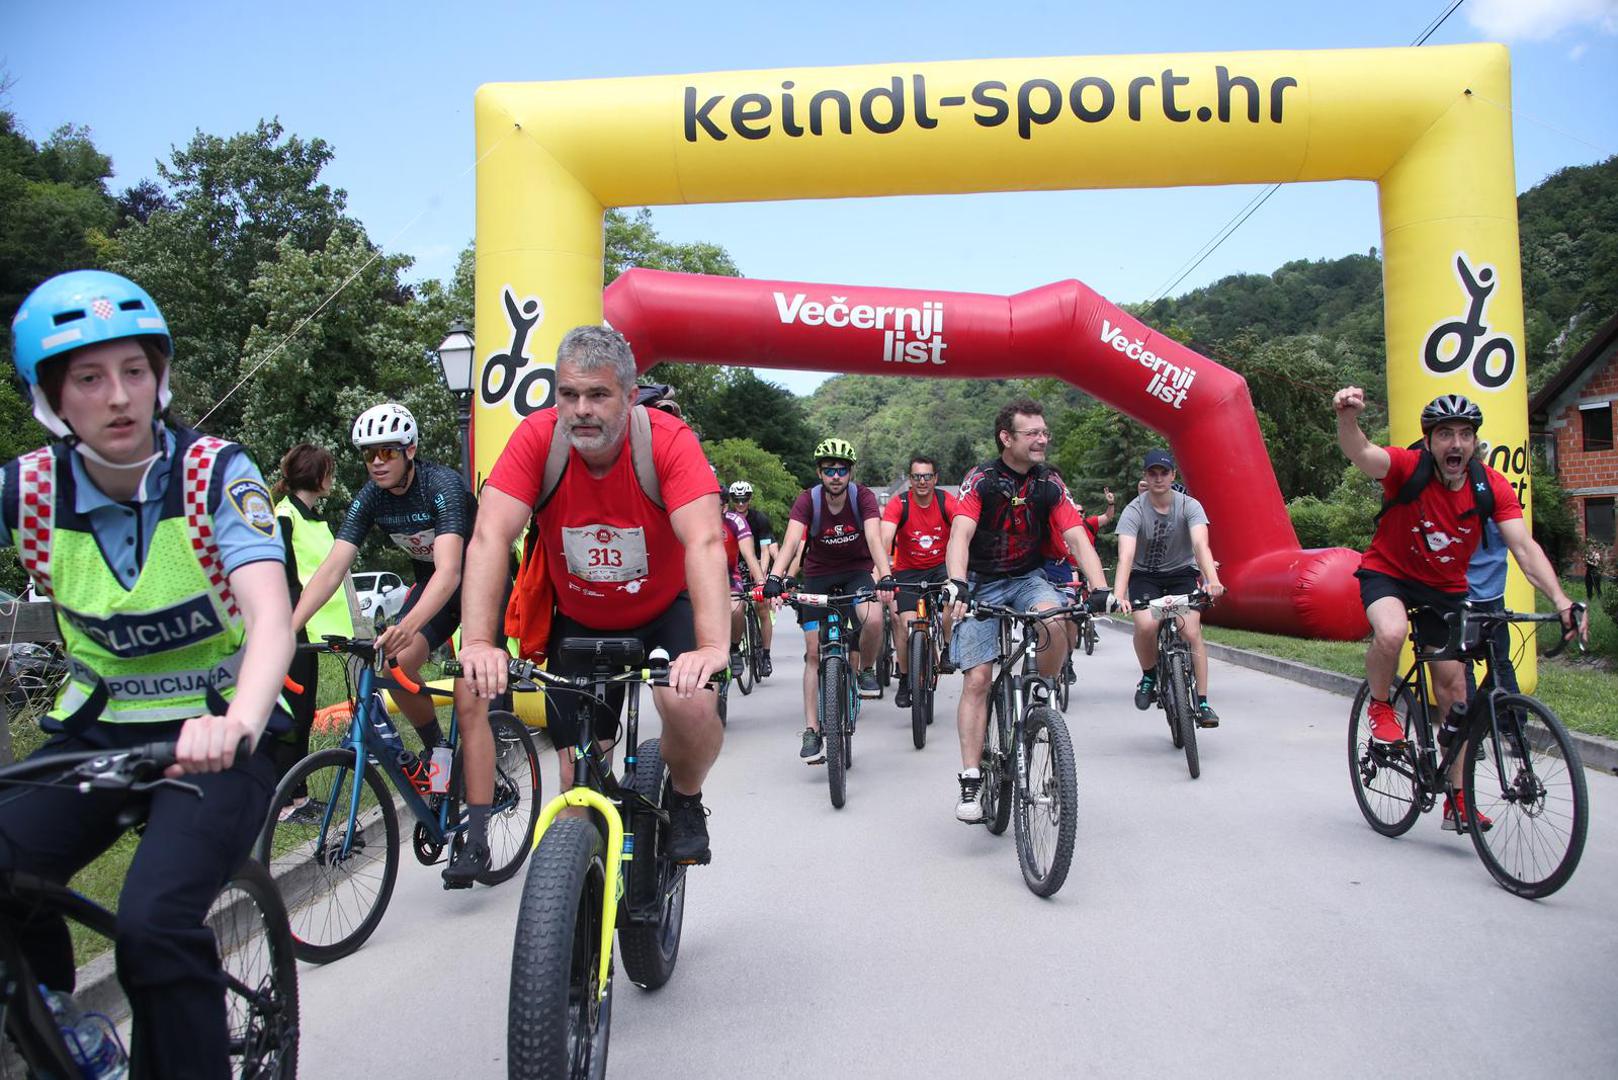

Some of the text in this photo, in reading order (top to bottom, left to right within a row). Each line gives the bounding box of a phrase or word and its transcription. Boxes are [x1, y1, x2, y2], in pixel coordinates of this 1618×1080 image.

[684, 65, 1298, 142] keindl-sport.hr
[773, 291, 943, 340] Večernji
[883, 330, 947, 365] list
[1101, 319, 1196, 390] Večernji
[1145, 373, 1187, 409] list
[588, 548, 623, 567] 313
[109, 673, 211, 696] POLICIJA
